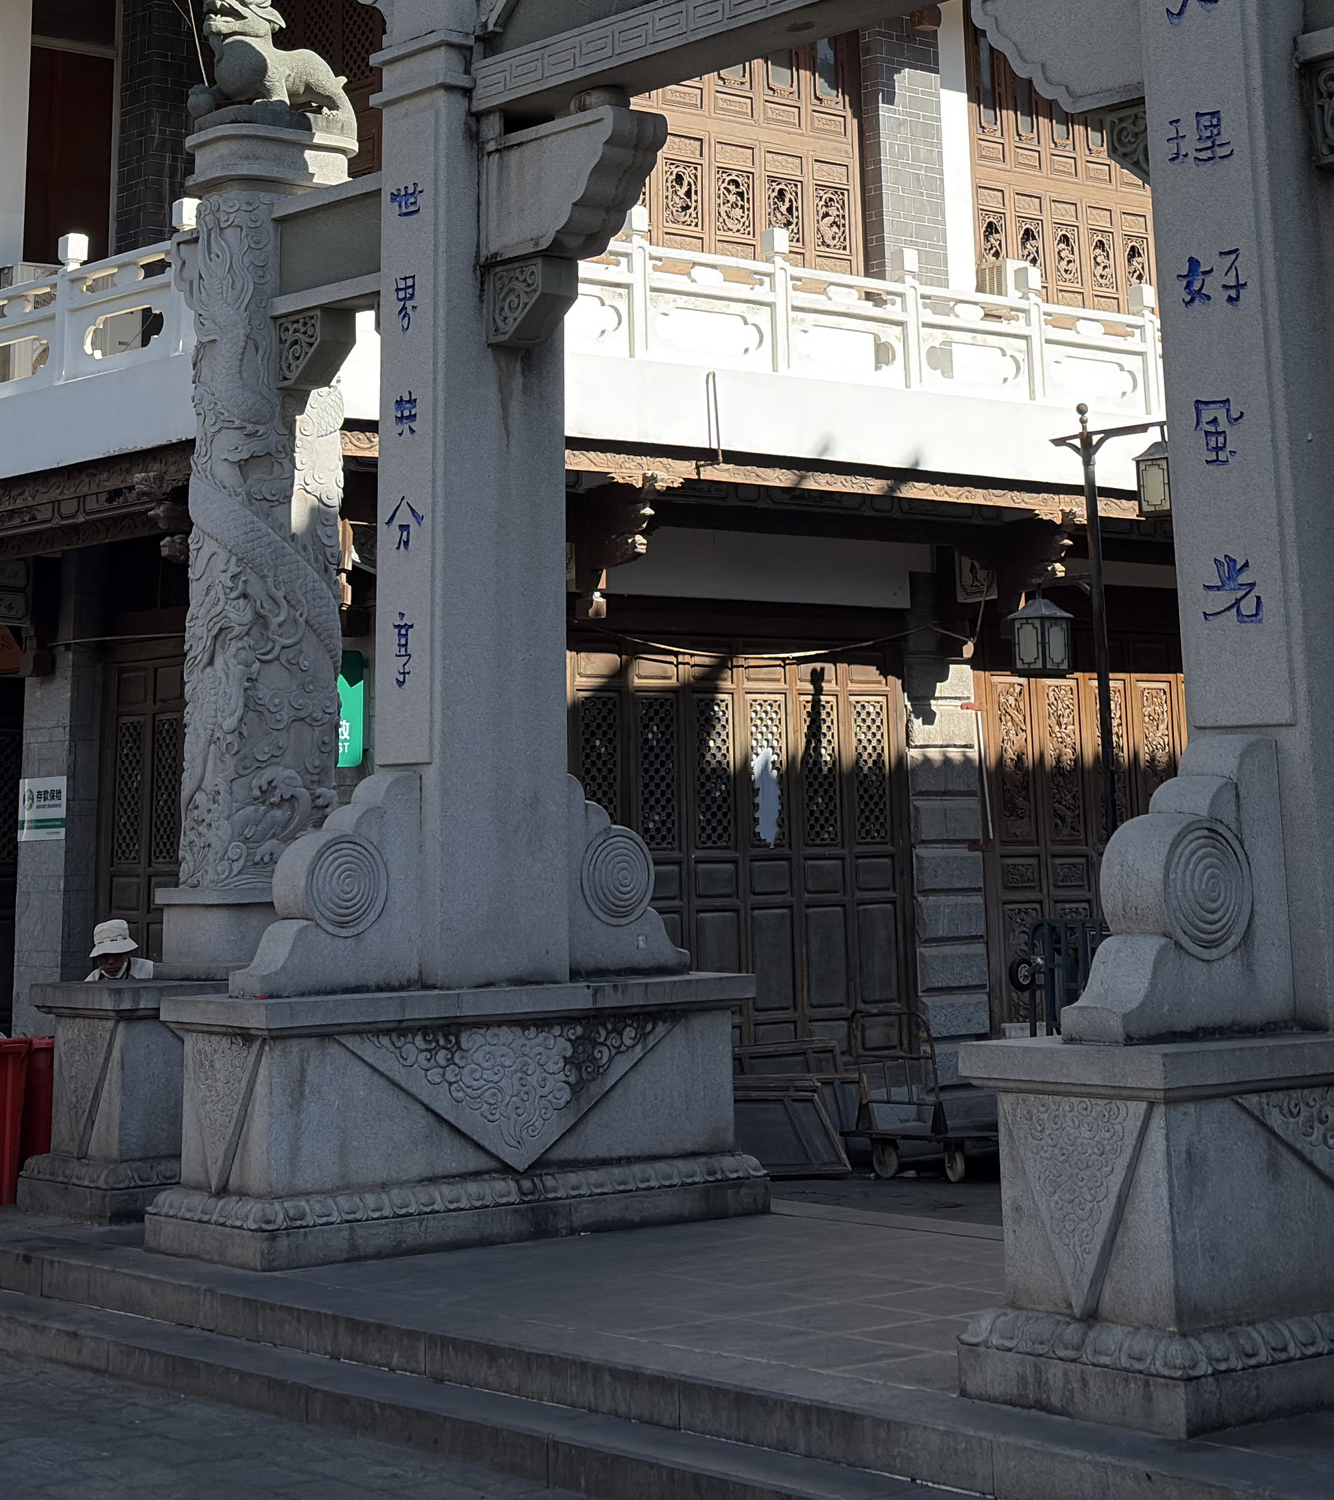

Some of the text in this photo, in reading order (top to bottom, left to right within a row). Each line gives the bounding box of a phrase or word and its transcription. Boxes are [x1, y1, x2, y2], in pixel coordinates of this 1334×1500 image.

[384, 182, 425, 690] 世界共分享
